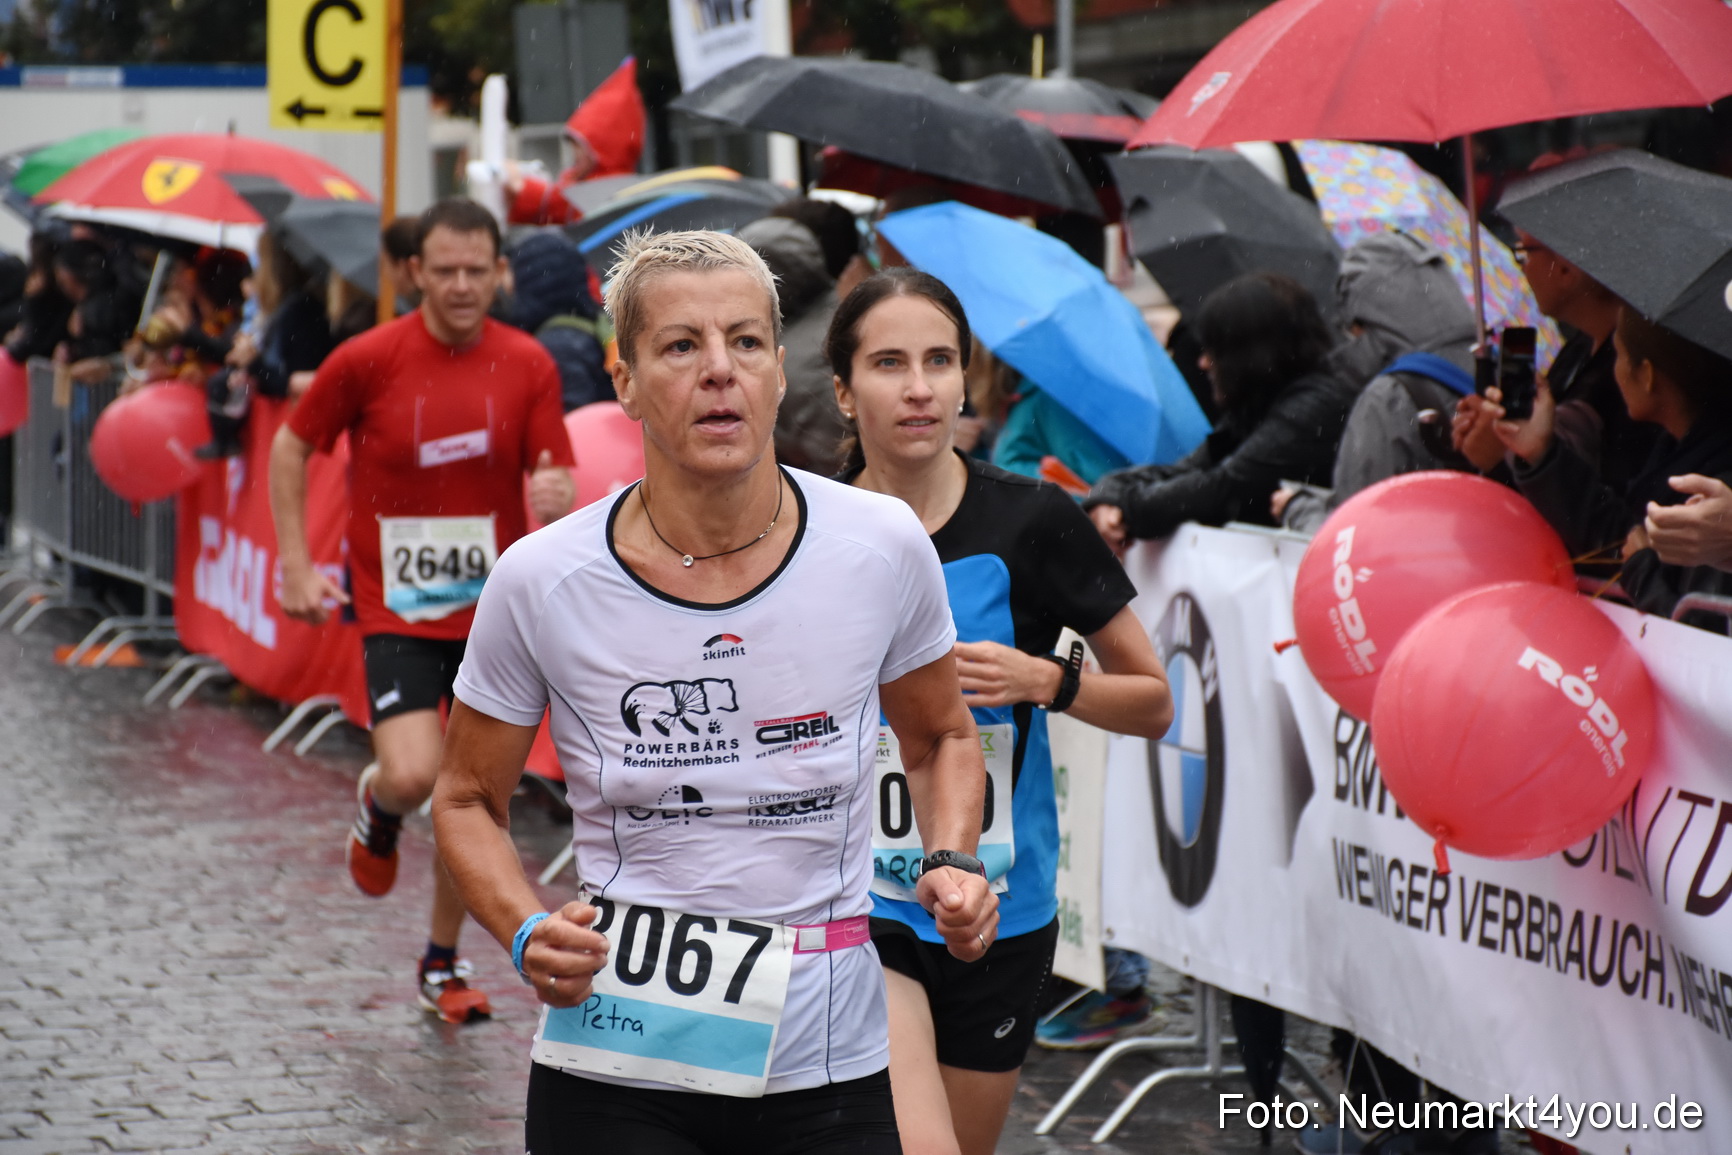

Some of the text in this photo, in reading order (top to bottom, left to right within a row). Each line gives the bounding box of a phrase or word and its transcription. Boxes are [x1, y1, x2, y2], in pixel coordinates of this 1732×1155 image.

[303, 0, 364, 87] C
[394, 547, 487, 584] 2649
[1333, 525, 1377, 673] RÖDL
[703, 646, 746, 661] skinfit
[1517, 645, 1629, 769] RÖDL
[755, 715, 840, 745] GREIL
[622, 752, 740, 768] Rednitzhembach
[624, 738, 740, 755] POWERBÄRS
[793, 739, 819, 754] STAHL
[748, 784, 842, 805] ELEKTROMOTOREN
[748, 813, 835, 827] REPARATURWERK
[1459, 875, 1674, 1009] VERBRAUCH.
[578, 994, 644, 1037] Petra
